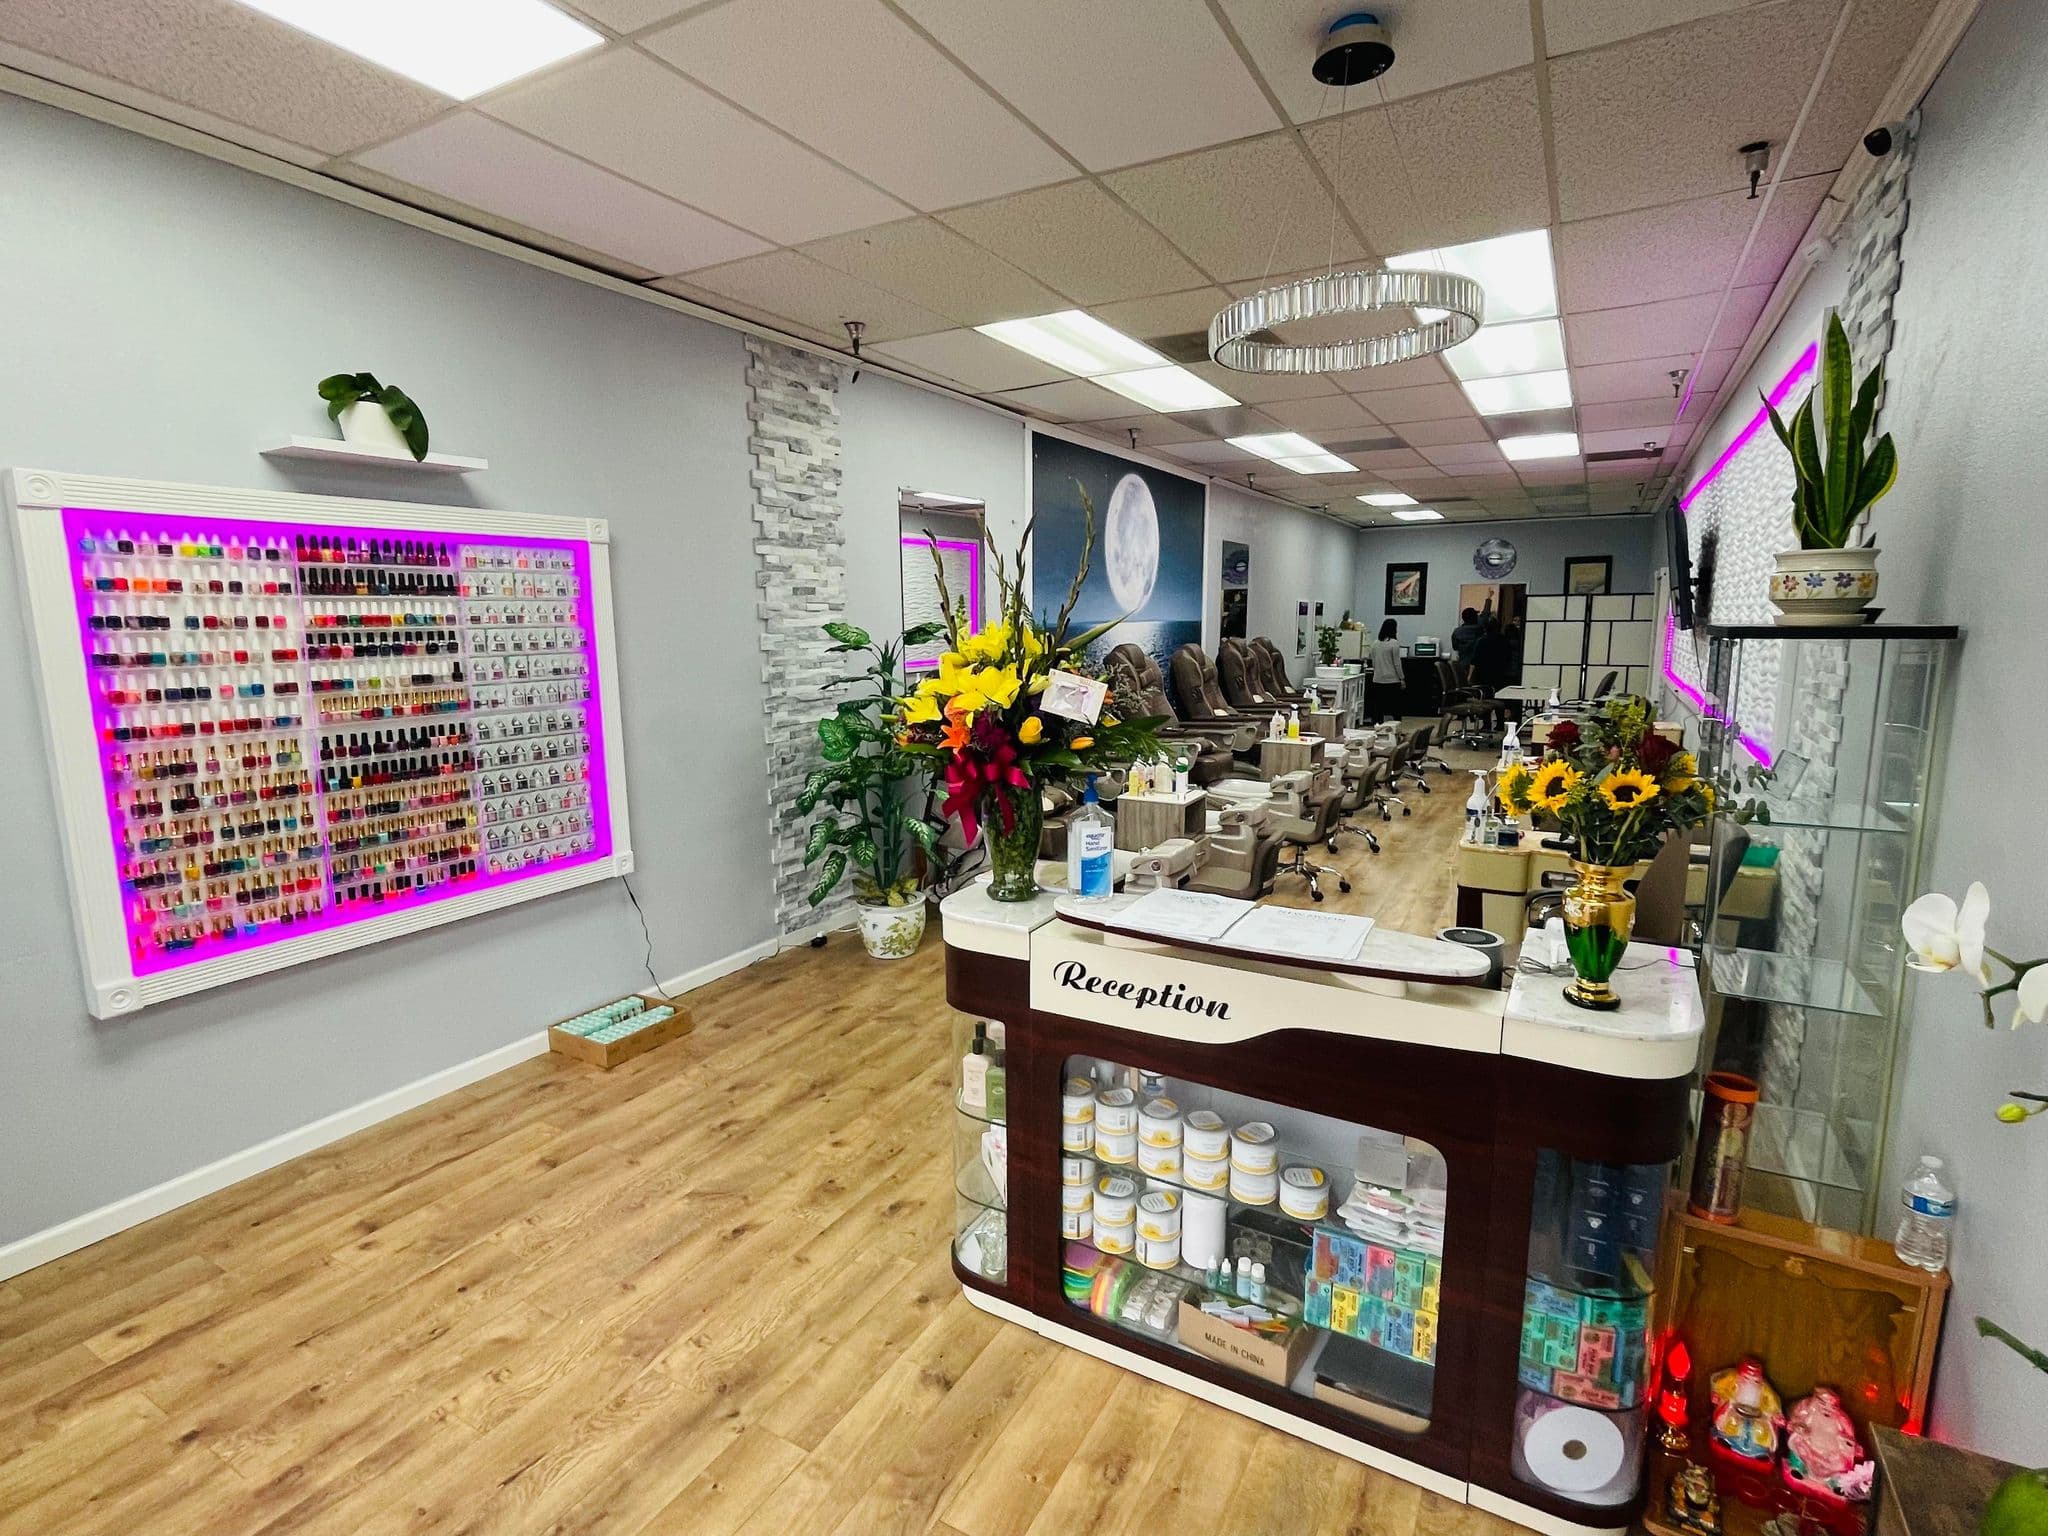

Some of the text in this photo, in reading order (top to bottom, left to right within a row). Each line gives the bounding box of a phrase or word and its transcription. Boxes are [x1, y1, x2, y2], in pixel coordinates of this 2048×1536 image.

[1053, 960, 1232, 1021] Reception
[1204, 1332, 1265, 1367] MADE IN CHINA
